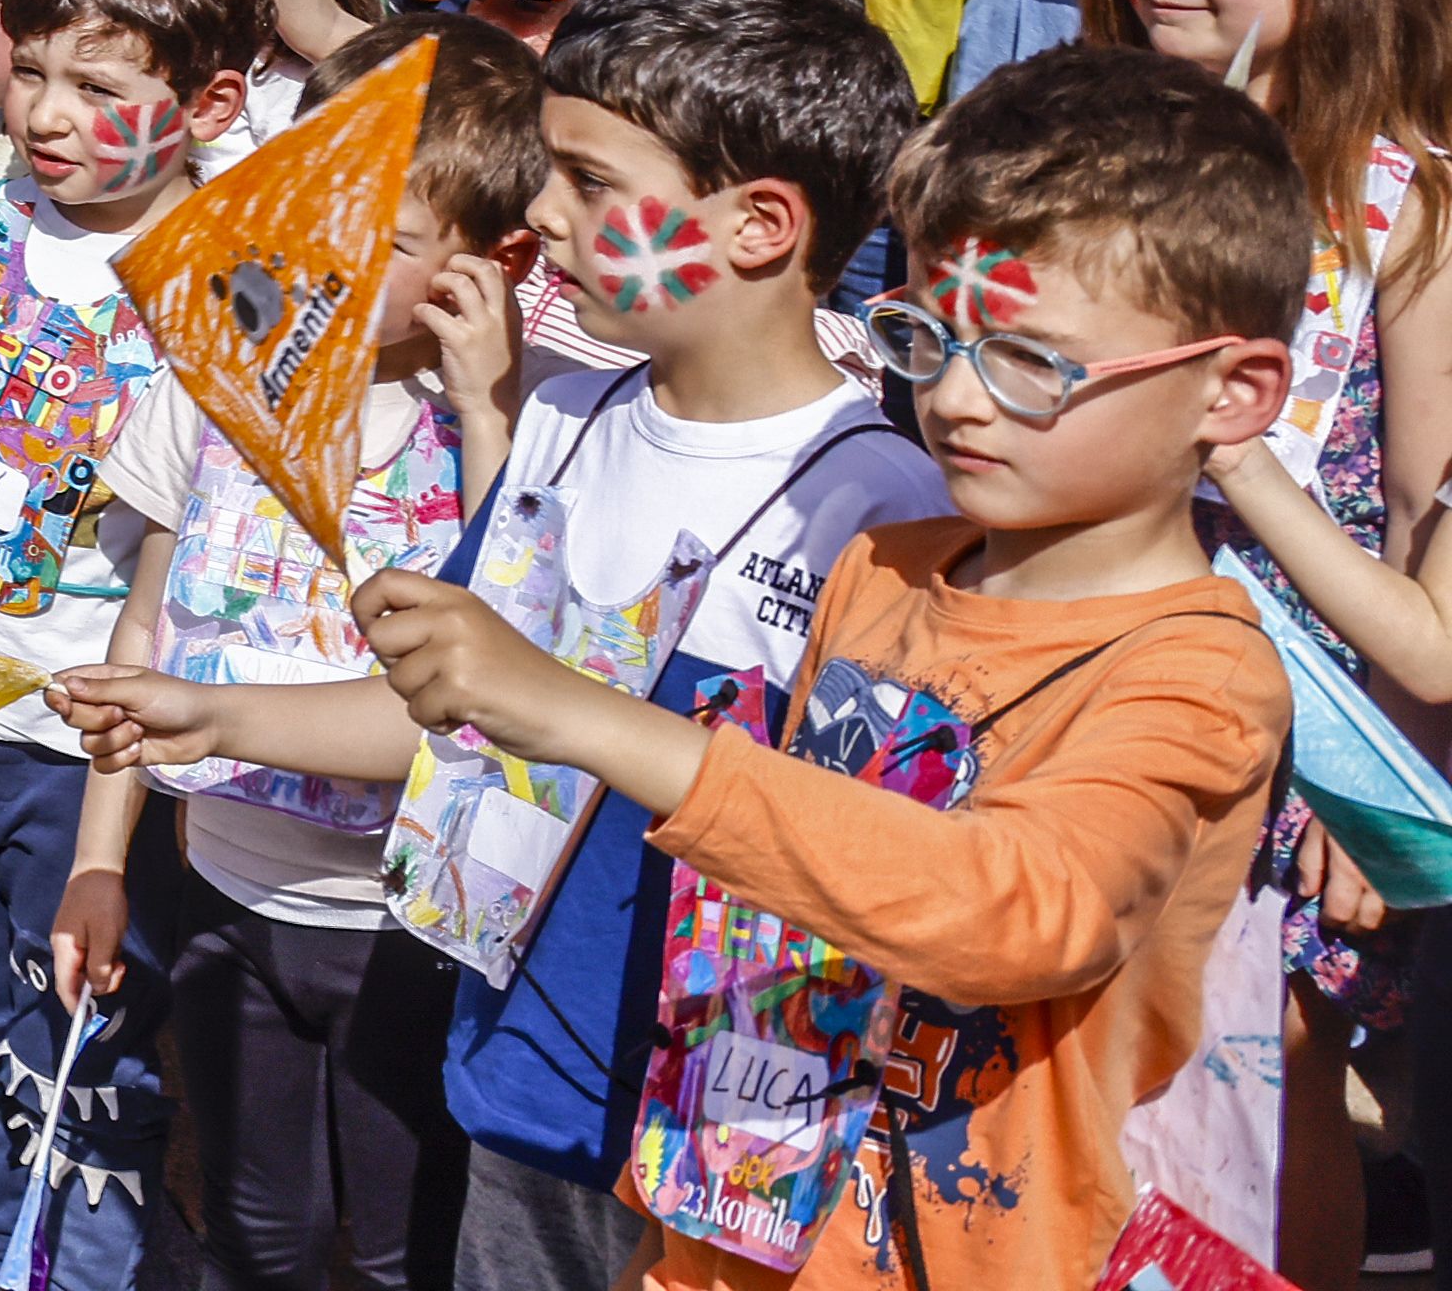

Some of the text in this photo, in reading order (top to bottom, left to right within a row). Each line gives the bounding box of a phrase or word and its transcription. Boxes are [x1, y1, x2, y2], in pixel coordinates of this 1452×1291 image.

[260, 271, 345, 413] Armentia
[711, 1046, 812, 1126] LUCA
[678, 1177, 802, 1254] 23.korrika
